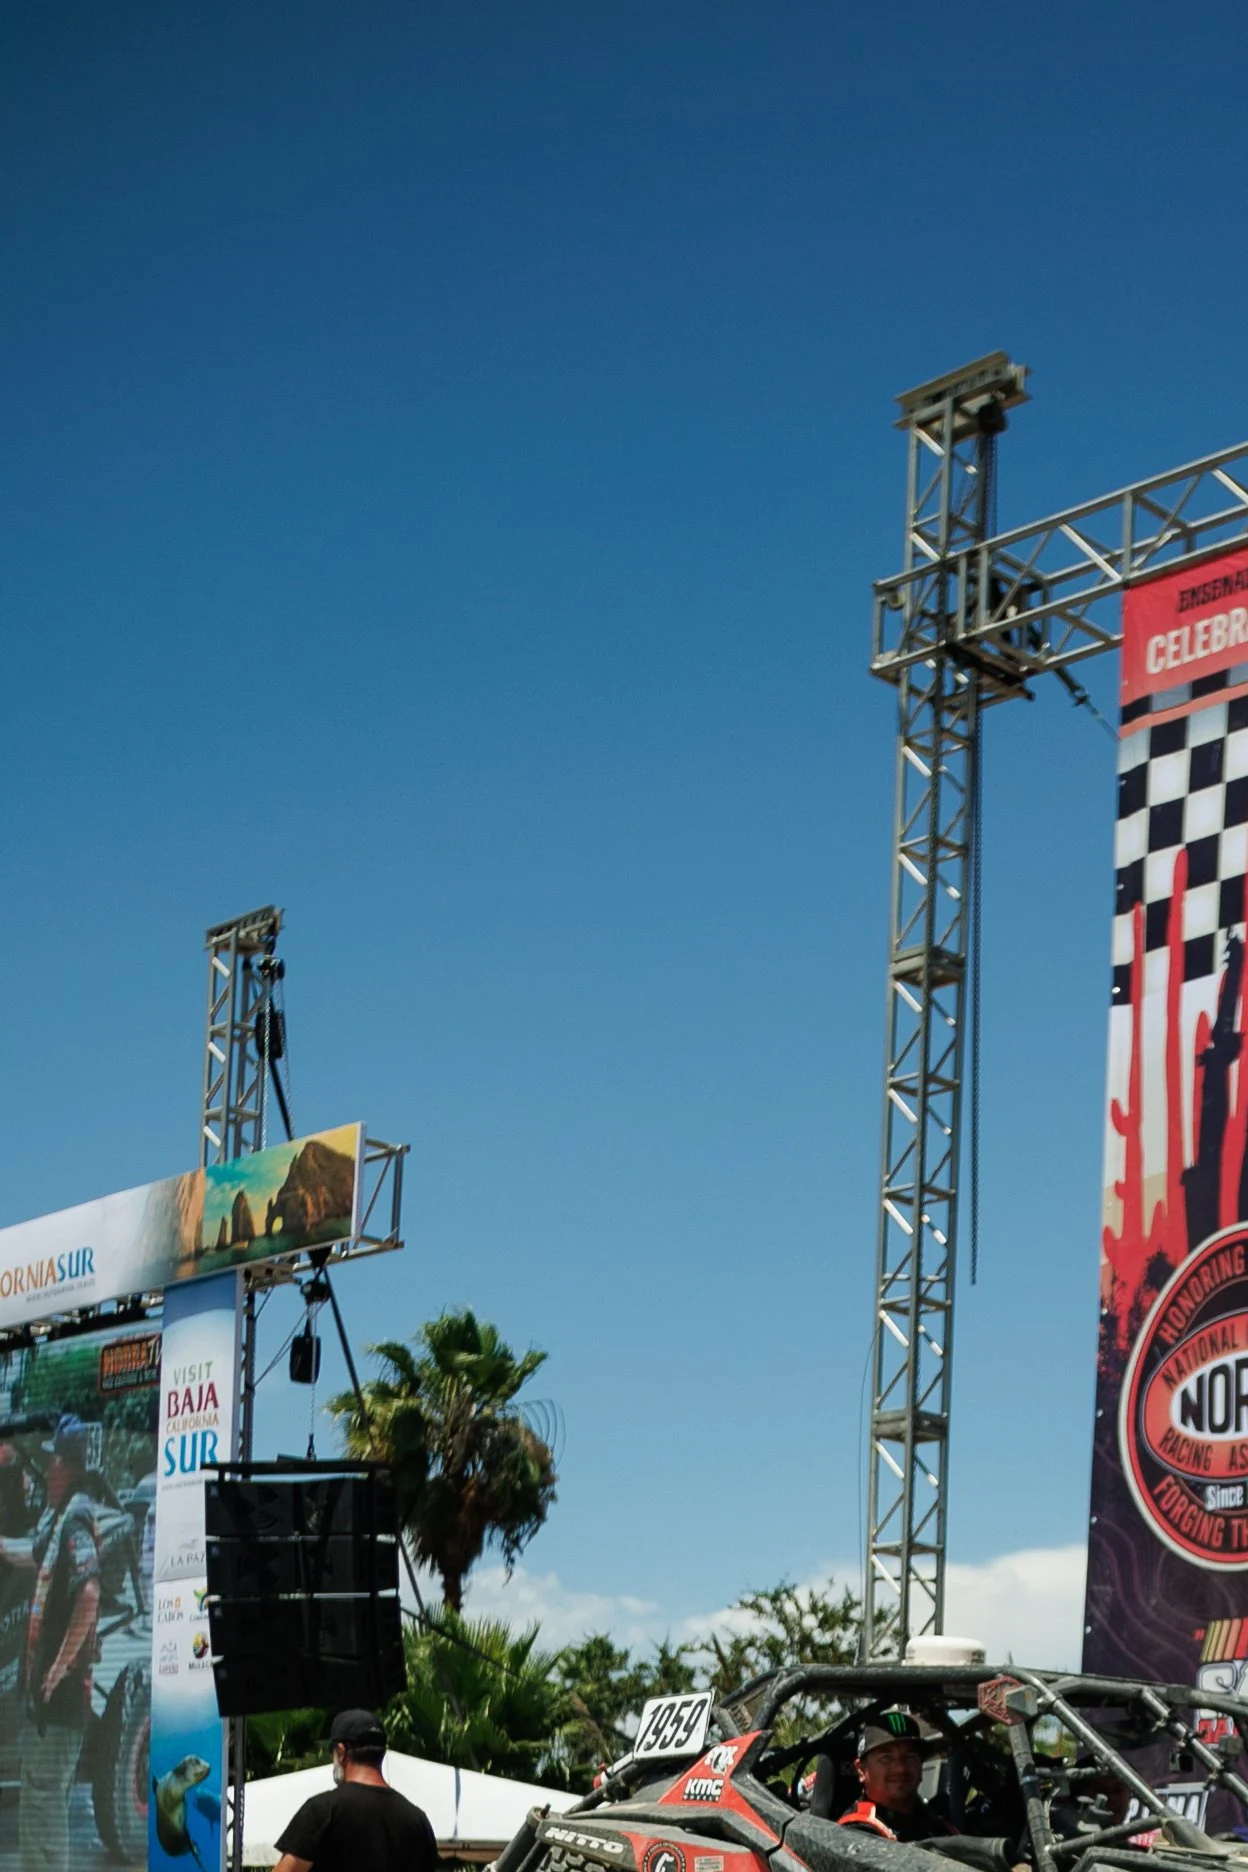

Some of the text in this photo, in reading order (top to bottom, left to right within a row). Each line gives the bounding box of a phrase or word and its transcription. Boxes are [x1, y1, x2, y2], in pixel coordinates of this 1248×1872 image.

[1158, 1246, 1246, 1344] HONORING
[174, 1361, 213, 1384] VISIT
[1162, 1324, 1240, 1392] NATIONAL
[167, 1381, 219, 1418] BAJA
[166, 1413, 219, 1434] CALIFORNIA
[164, 1430, 218, 1477] SUR
[1159, 1427, 1212, 1473] RACING
[1153, 1474, 1225, 1548] FORGING
[1205, 1483, 1244, 1512] Since
[636, 1699, 708, 1752] 1959
[684, 1778, 724, 1796] KMC
[545, 1827, 624, 1853] NITTO
